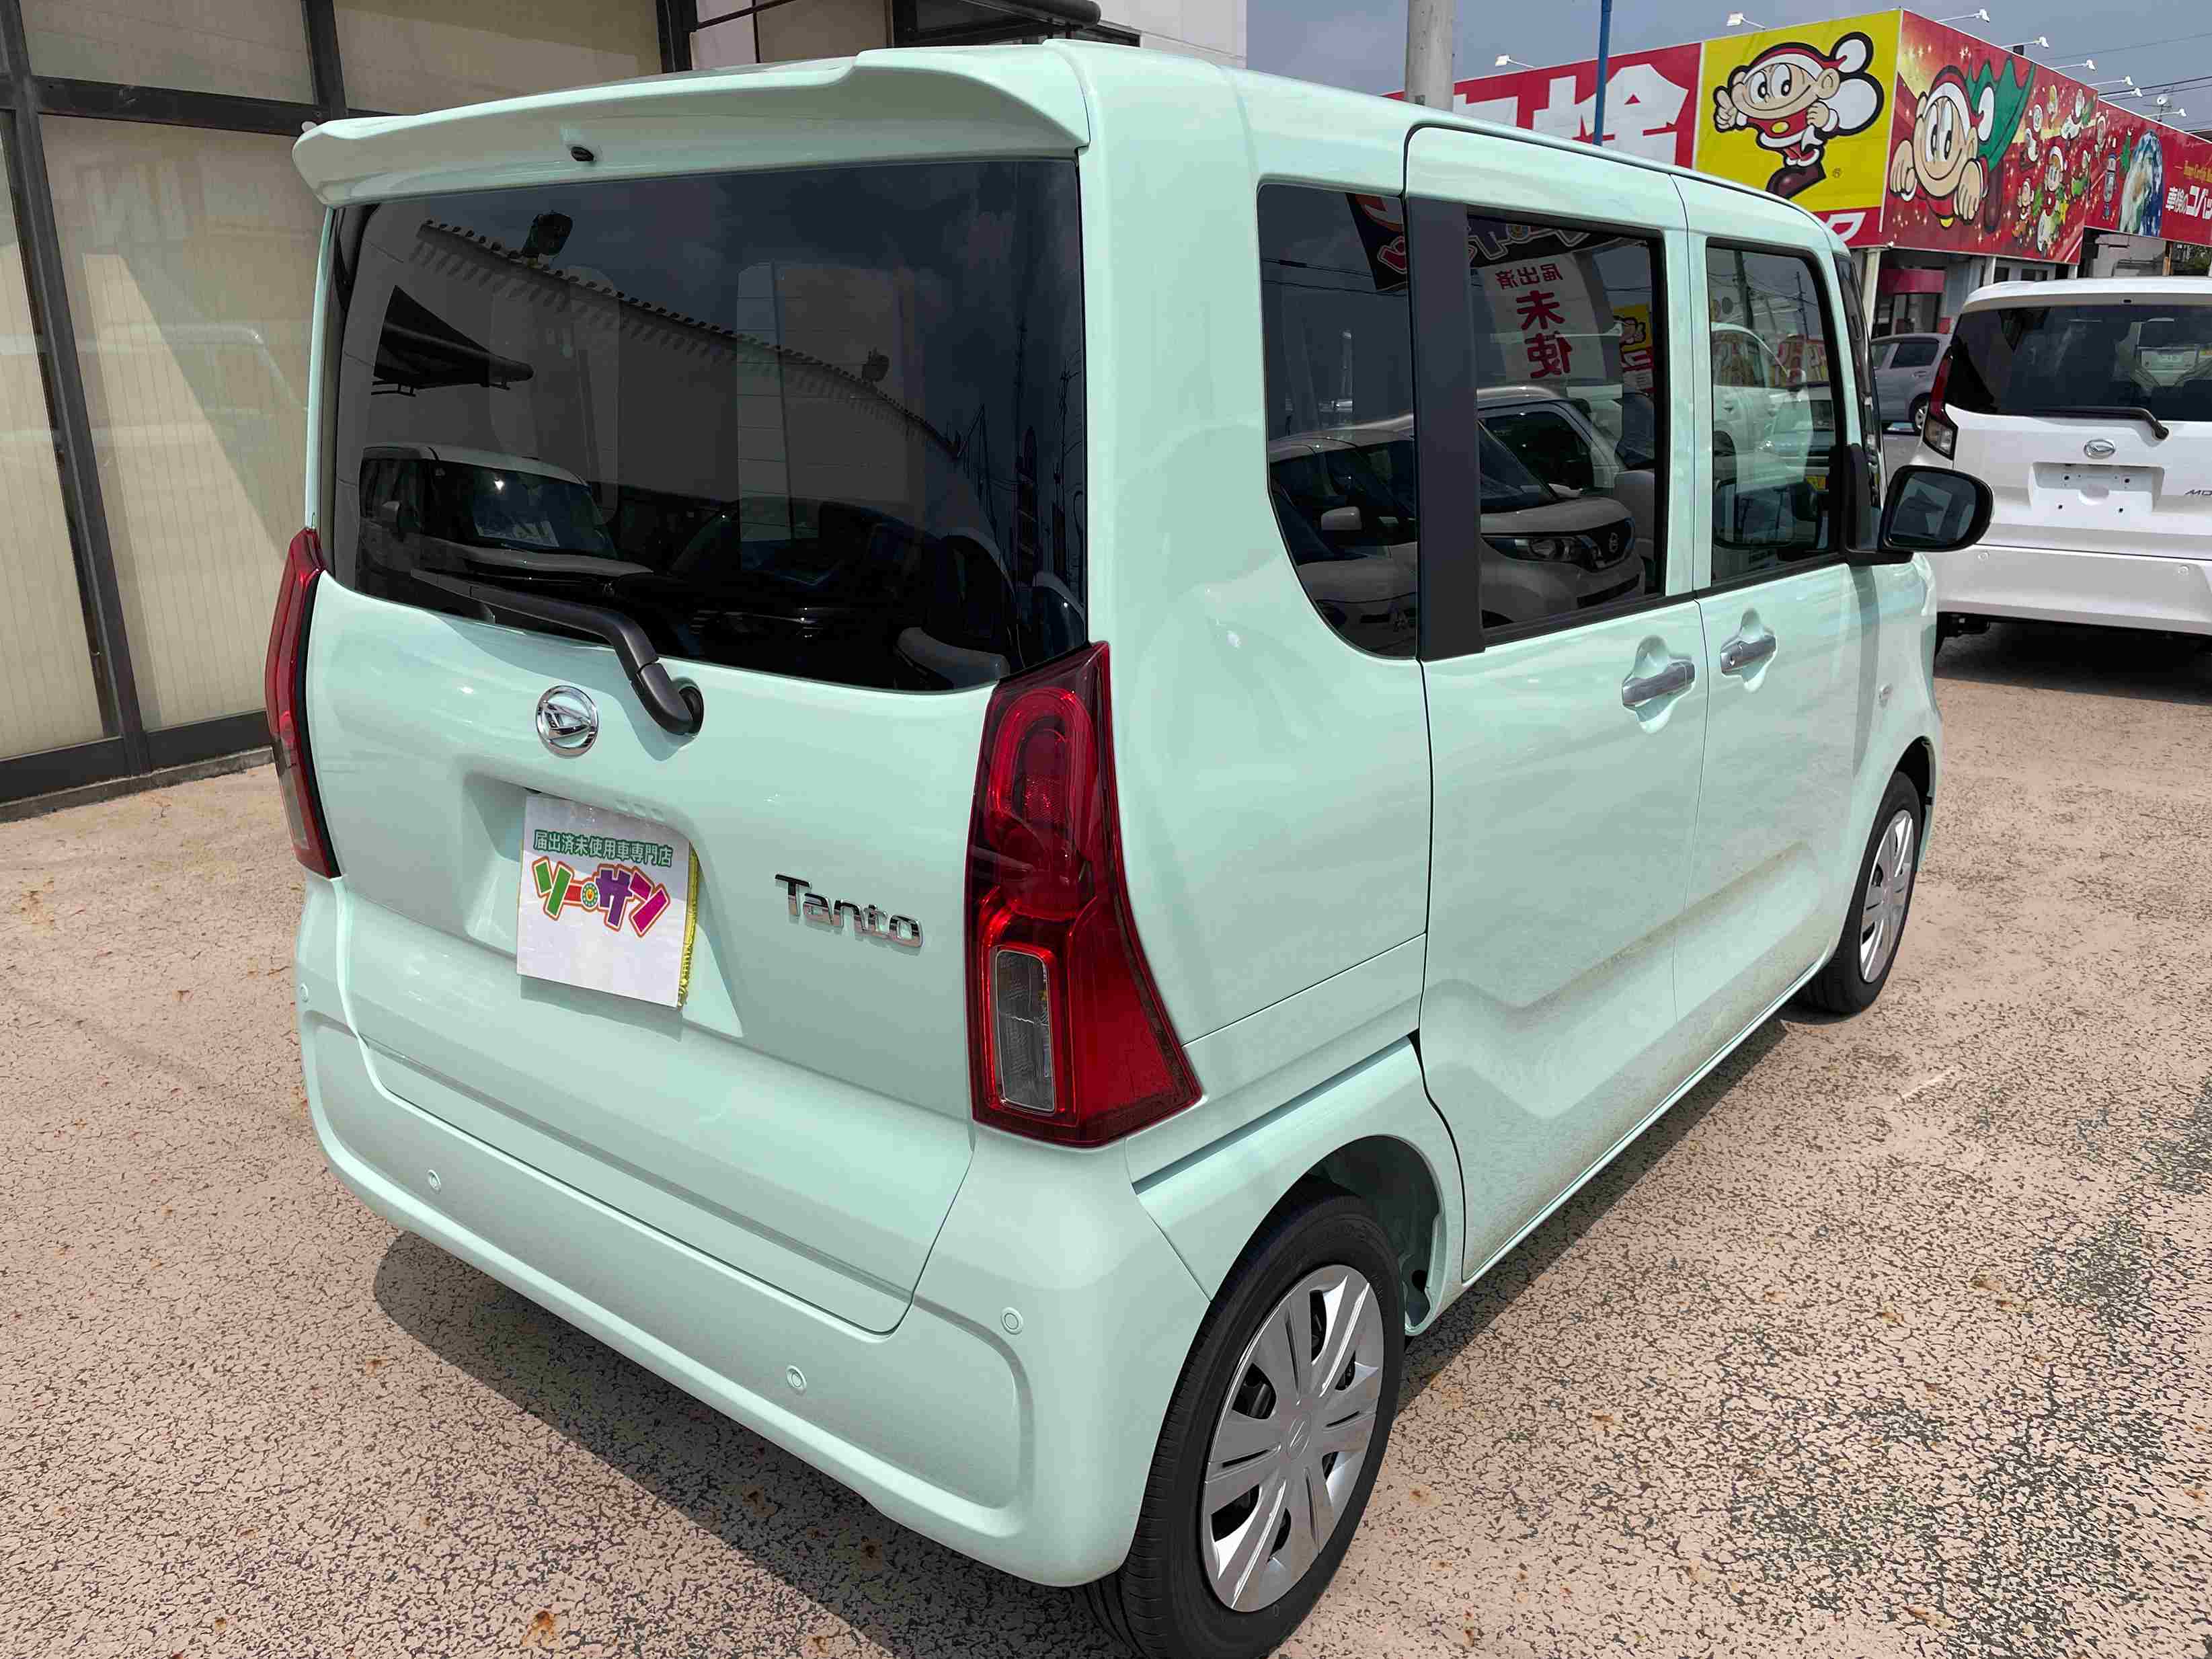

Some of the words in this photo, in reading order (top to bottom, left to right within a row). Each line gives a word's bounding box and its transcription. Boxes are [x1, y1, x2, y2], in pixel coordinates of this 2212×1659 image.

[533, 829, 674, 867] 届出済未使用車専門店
[775, 874, 924, 948] Tanto
